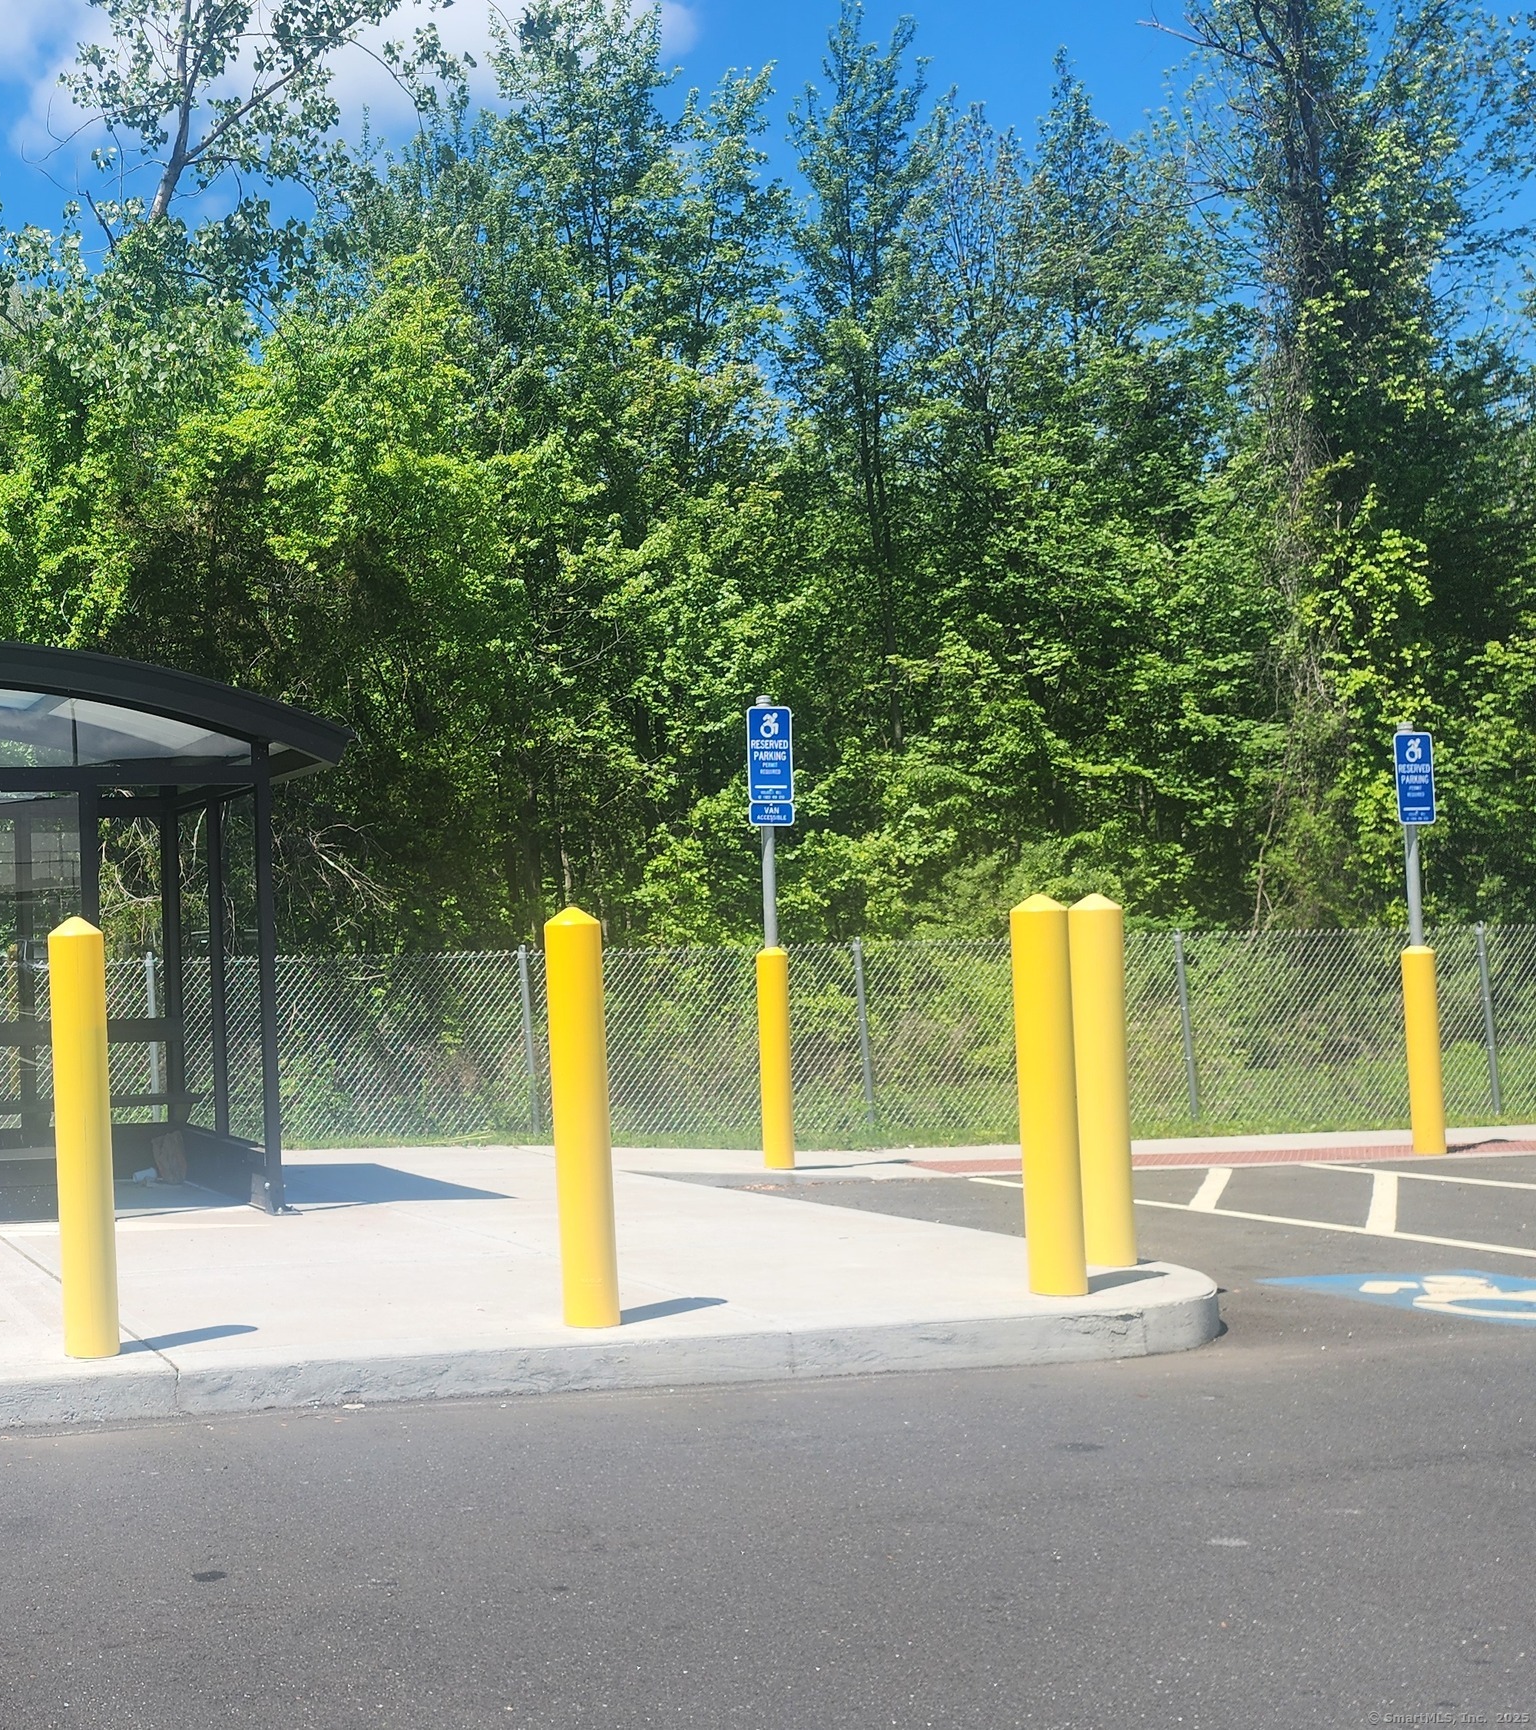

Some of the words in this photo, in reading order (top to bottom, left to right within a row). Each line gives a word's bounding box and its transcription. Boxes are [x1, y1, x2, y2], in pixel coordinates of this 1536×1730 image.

[750, 739, 789, 750] RESERVED
[753, 750, 787, 761] PARKING
[1398, 763, 1431, 774] RESERVED
[1400, 774, 1430, 785] PARKING
[764, 806, 780, 814] VAN
